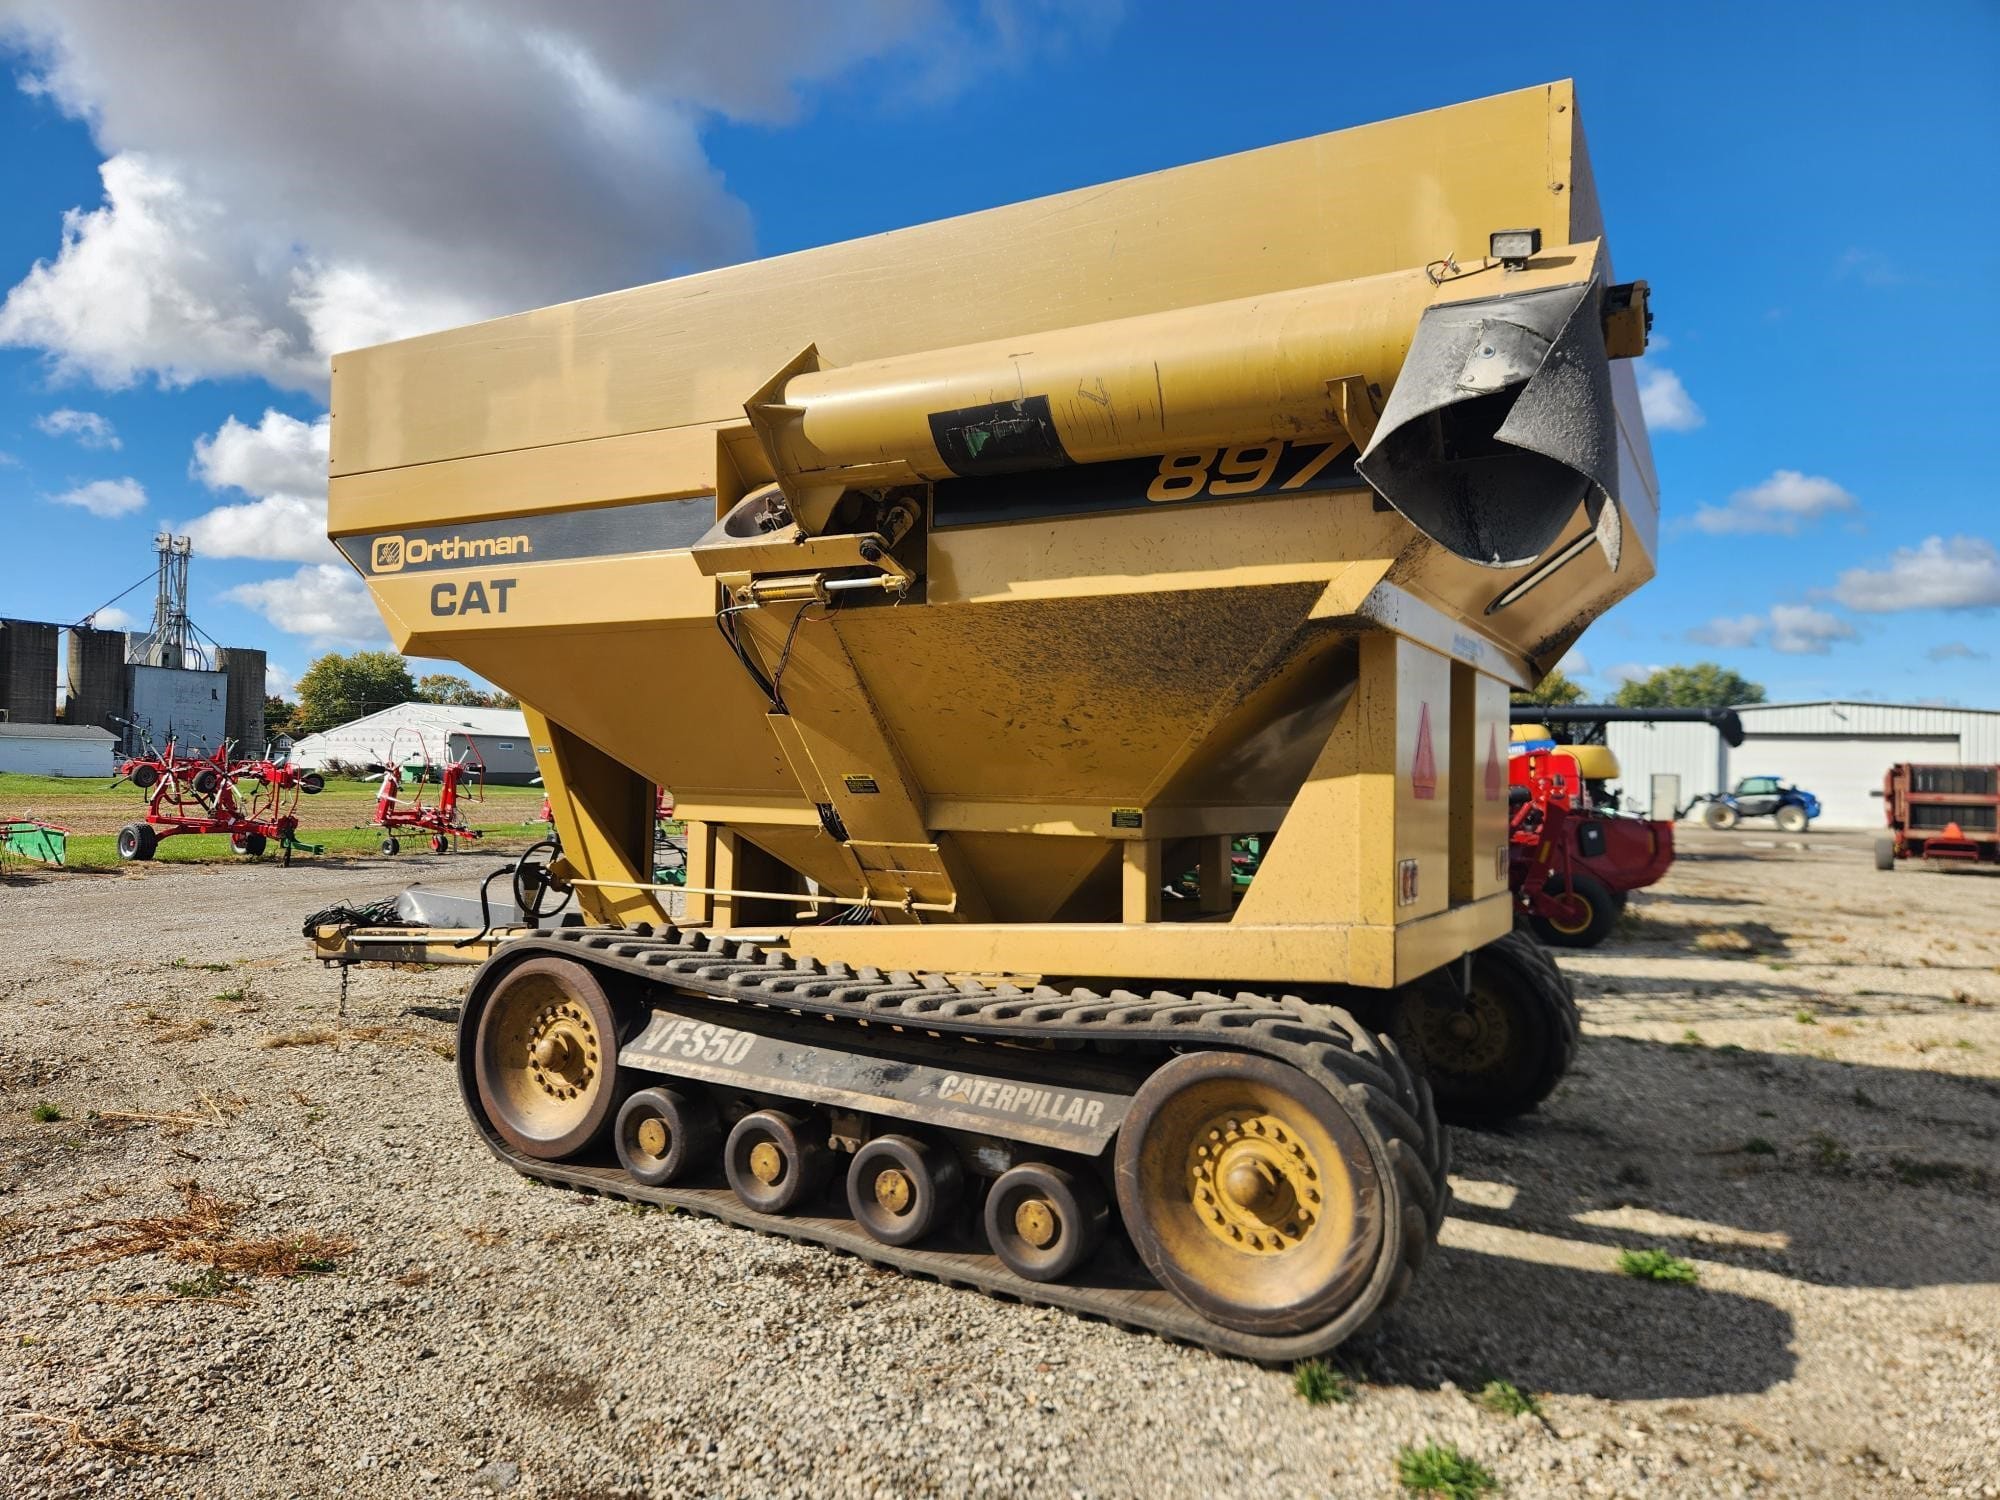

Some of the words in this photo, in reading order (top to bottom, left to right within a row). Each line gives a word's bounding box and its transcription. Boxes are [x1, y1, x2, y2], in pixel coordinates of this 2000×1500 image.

[1146, 439, 1352, 502] 897
[406, 535, 529, 564] Orthman
[430, 578, 517, 617] CAT
[641, 1018, 758, 1066] VFS50
[937, 1074, 1105, 1128] CATERPILLAR
